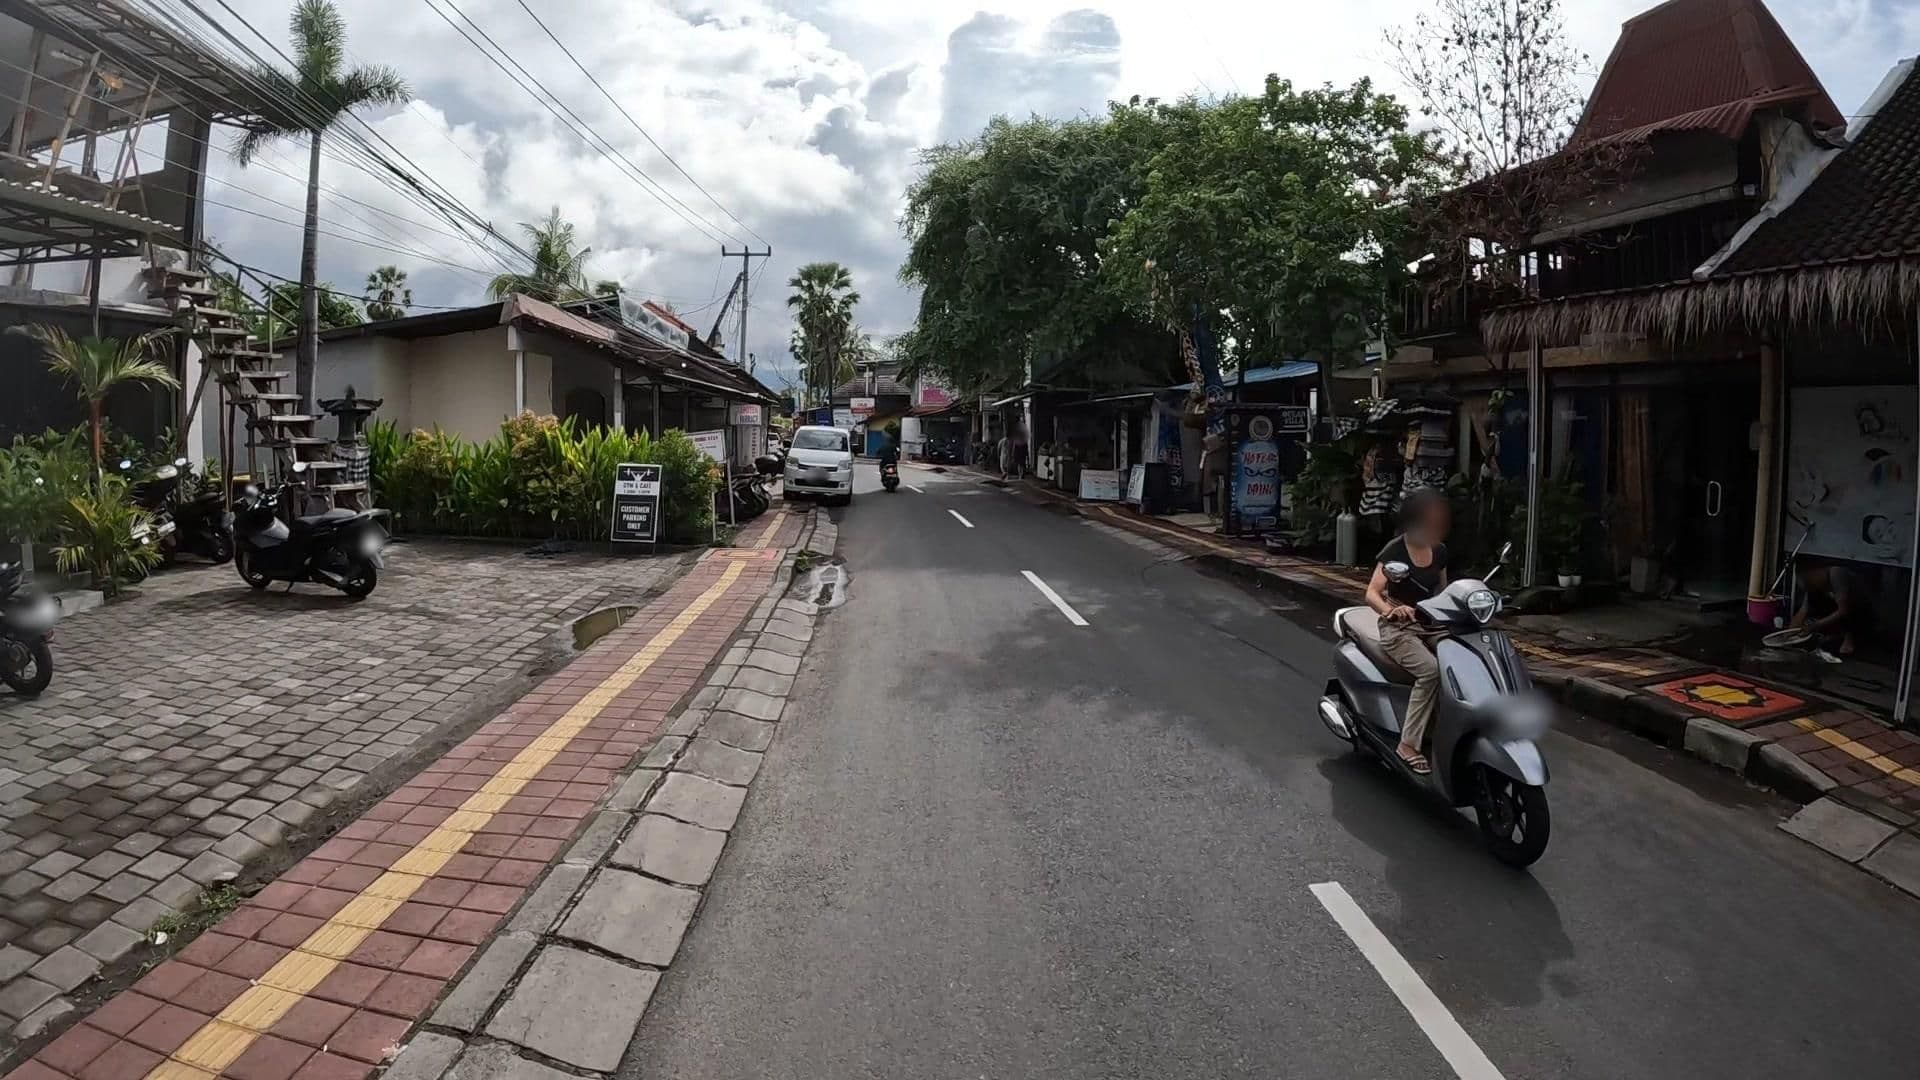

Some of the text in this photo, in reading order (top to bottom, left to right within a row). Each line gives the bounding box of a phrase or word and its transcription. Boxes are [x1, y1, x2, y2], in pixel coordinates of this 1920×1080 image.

[620, 505, 650, 513] CUSTOMER
[622, 513, 647, 521] PARKING
[627, 522, 641, 530] ONLY
